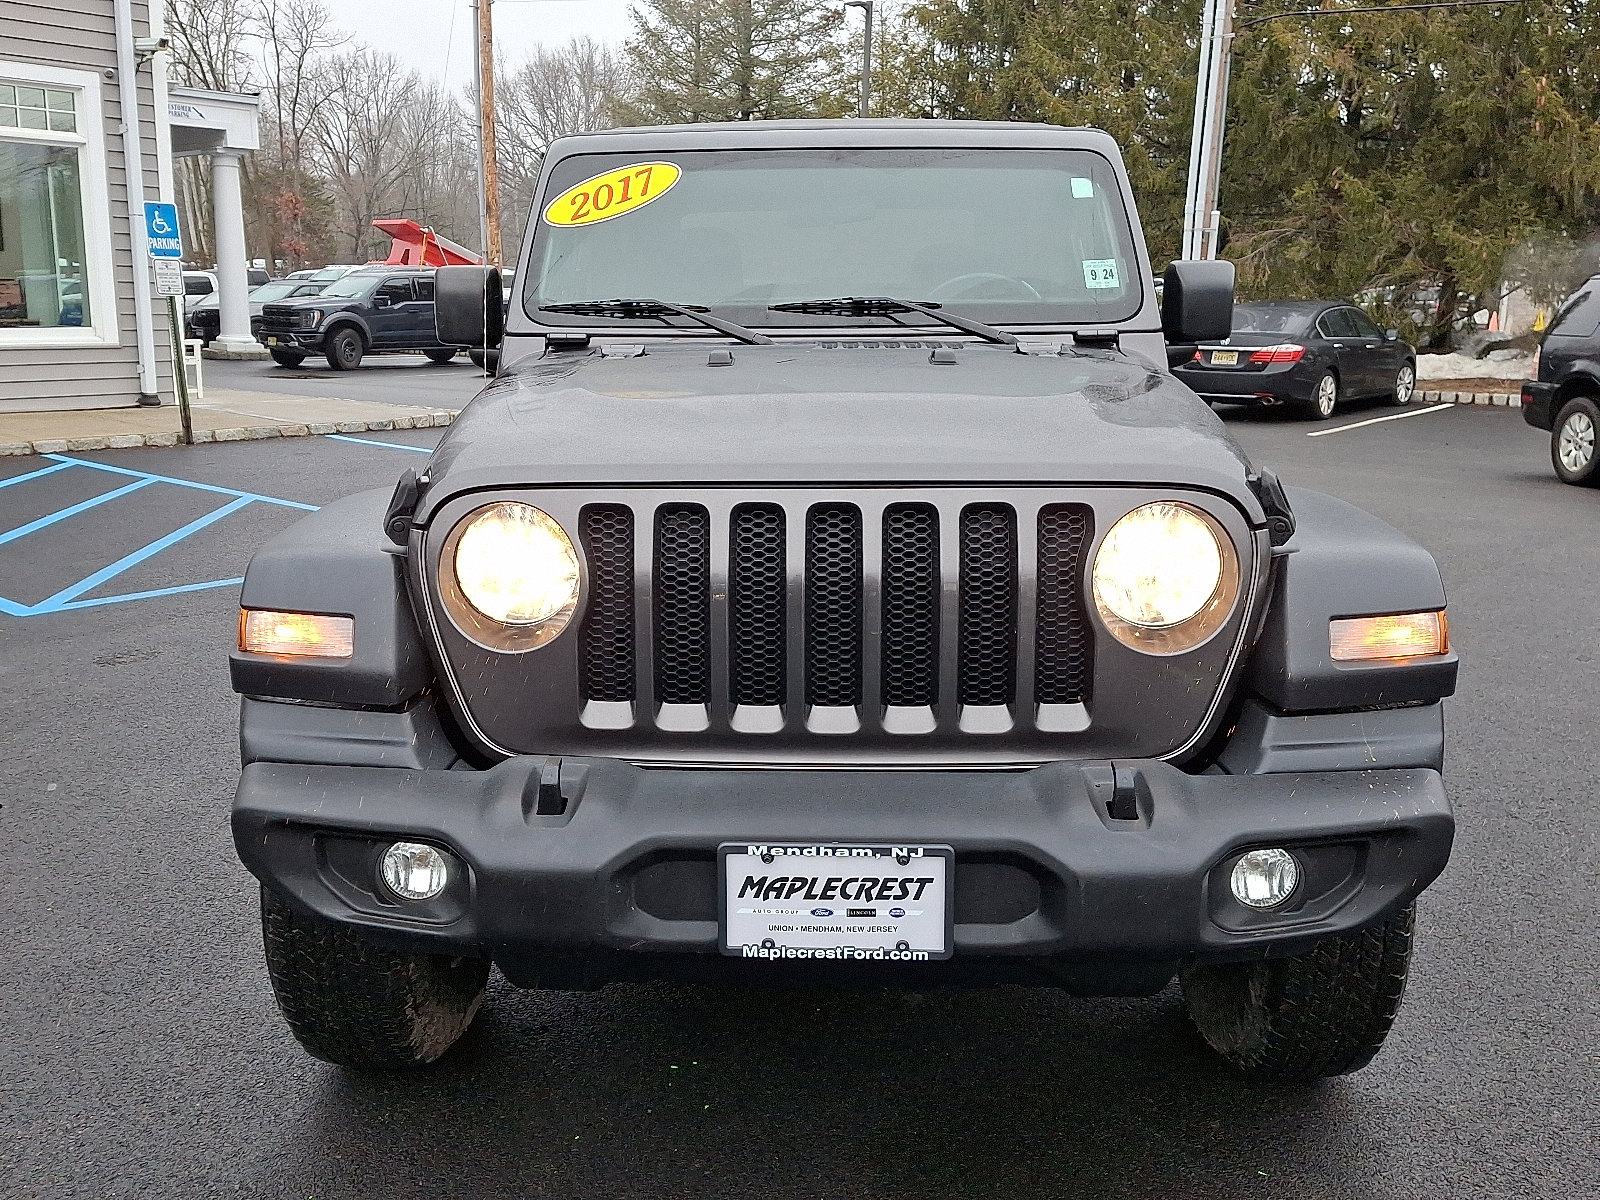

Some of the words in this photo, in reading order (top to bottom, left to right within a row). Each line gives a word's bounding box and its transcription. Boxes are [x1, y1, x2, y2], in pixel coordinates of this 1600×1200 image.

[570, 167, 653, 221] 2017
[149, 237, 180, 250] PARKING
[1090, 269, 1097, 281] 9
[1102, 268, 1115, 280] 24
[747, 845, 882, 860] Mendham,
[891, 846, 924, 859] NJ
[737, 876, 935, 903] MAPLECREST
[800, 925, 845, 934] MENDHAM,
[866, 926, 899, 934] JERSEY
[742, 945, 929, 961] MaplecrestFord.com
